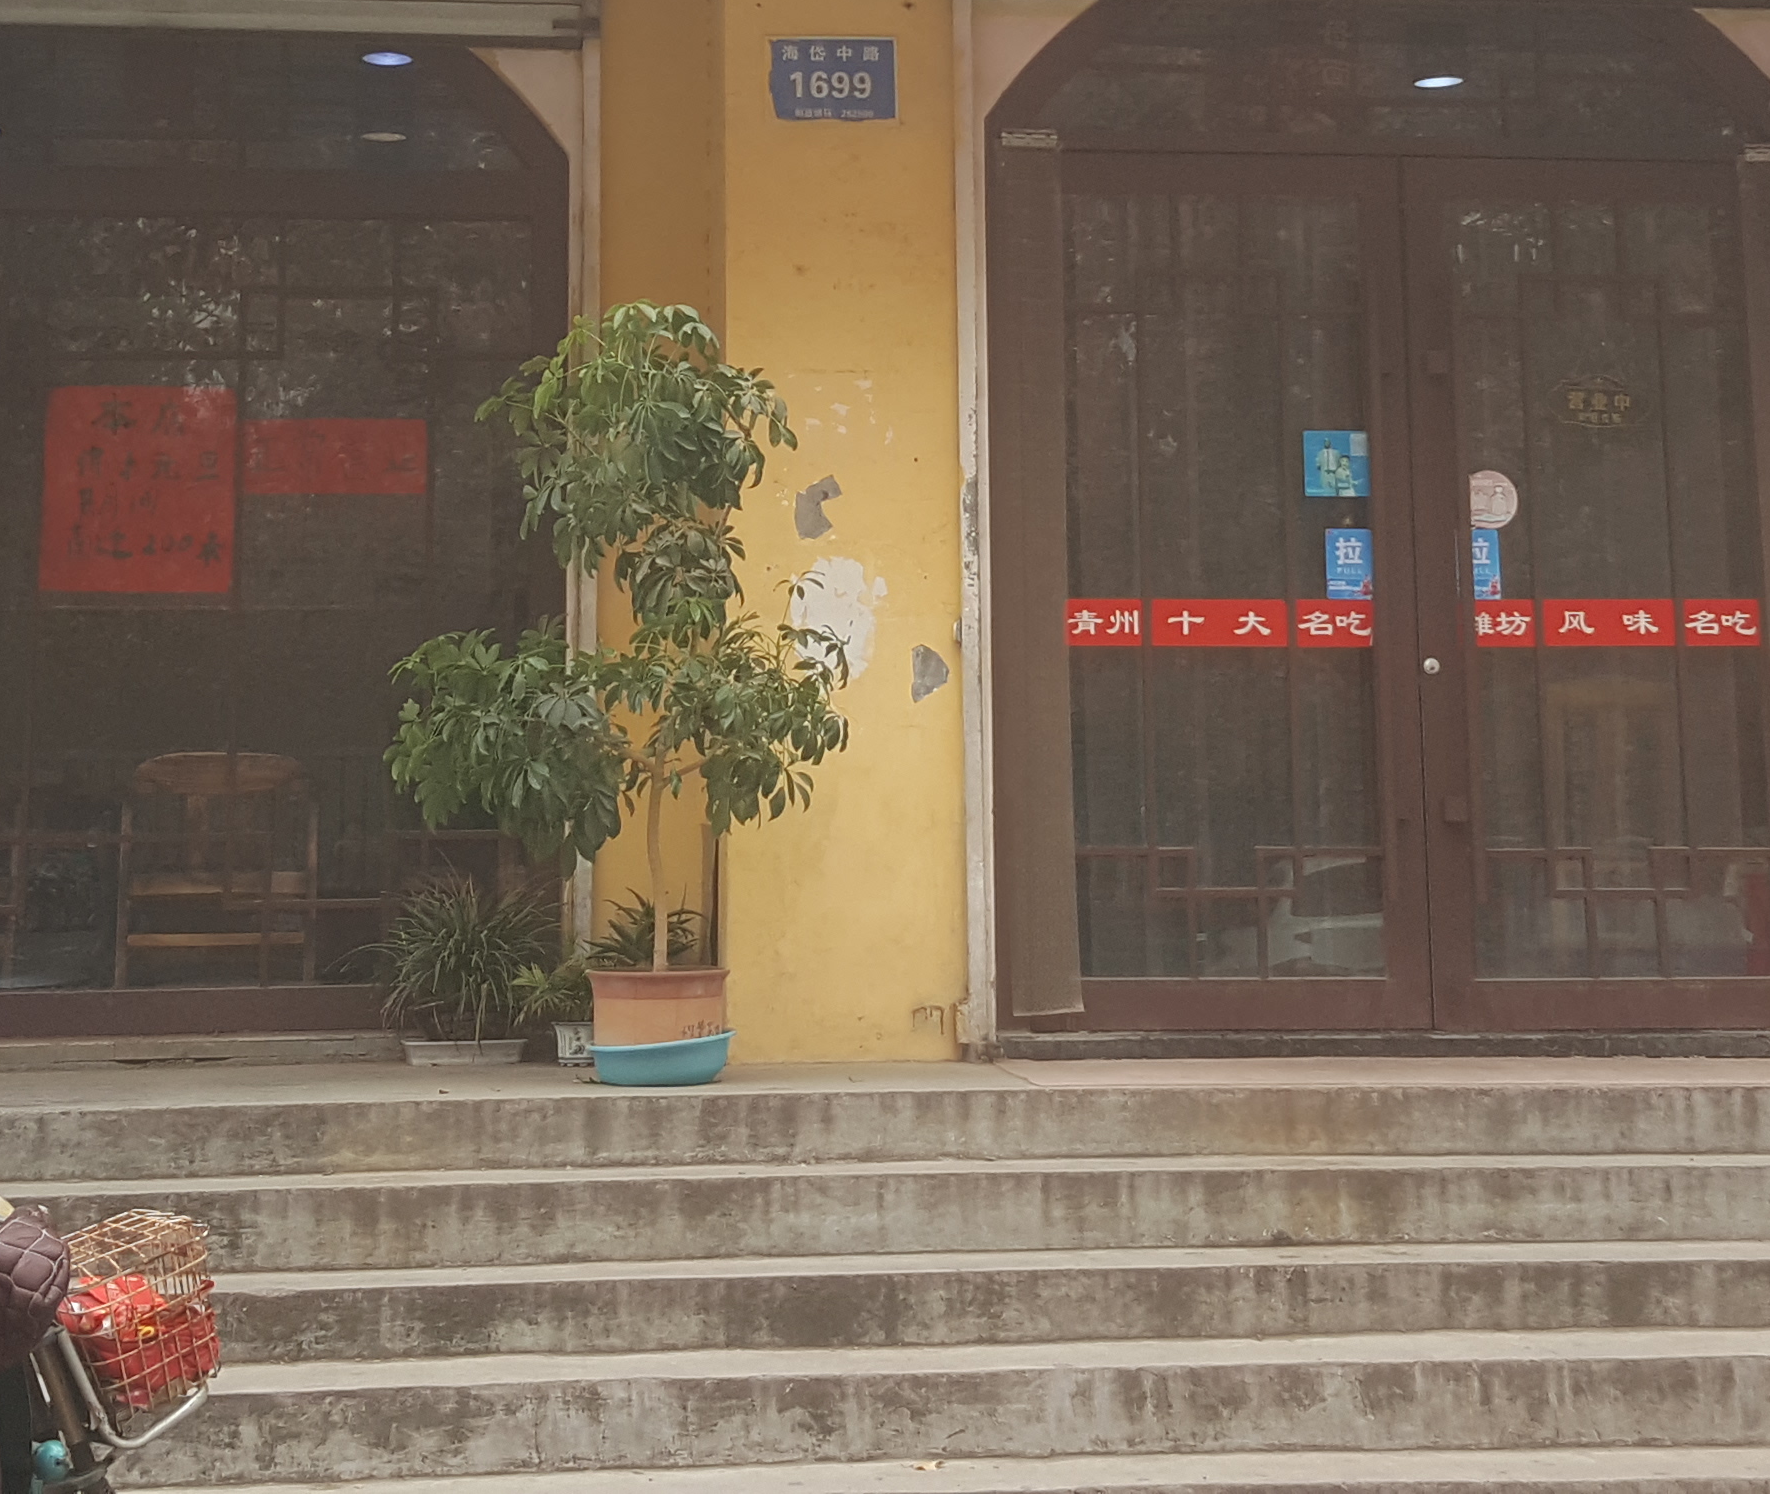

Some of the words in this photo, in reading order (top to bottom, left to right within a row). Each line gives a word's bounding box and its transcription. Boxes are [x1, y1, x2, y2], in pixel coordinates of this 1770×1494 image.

[781, 45, 880, 62] 海岱中路
[789, 71, 872, 99] 1699
[1335, 537, 1363, 565] 拉
